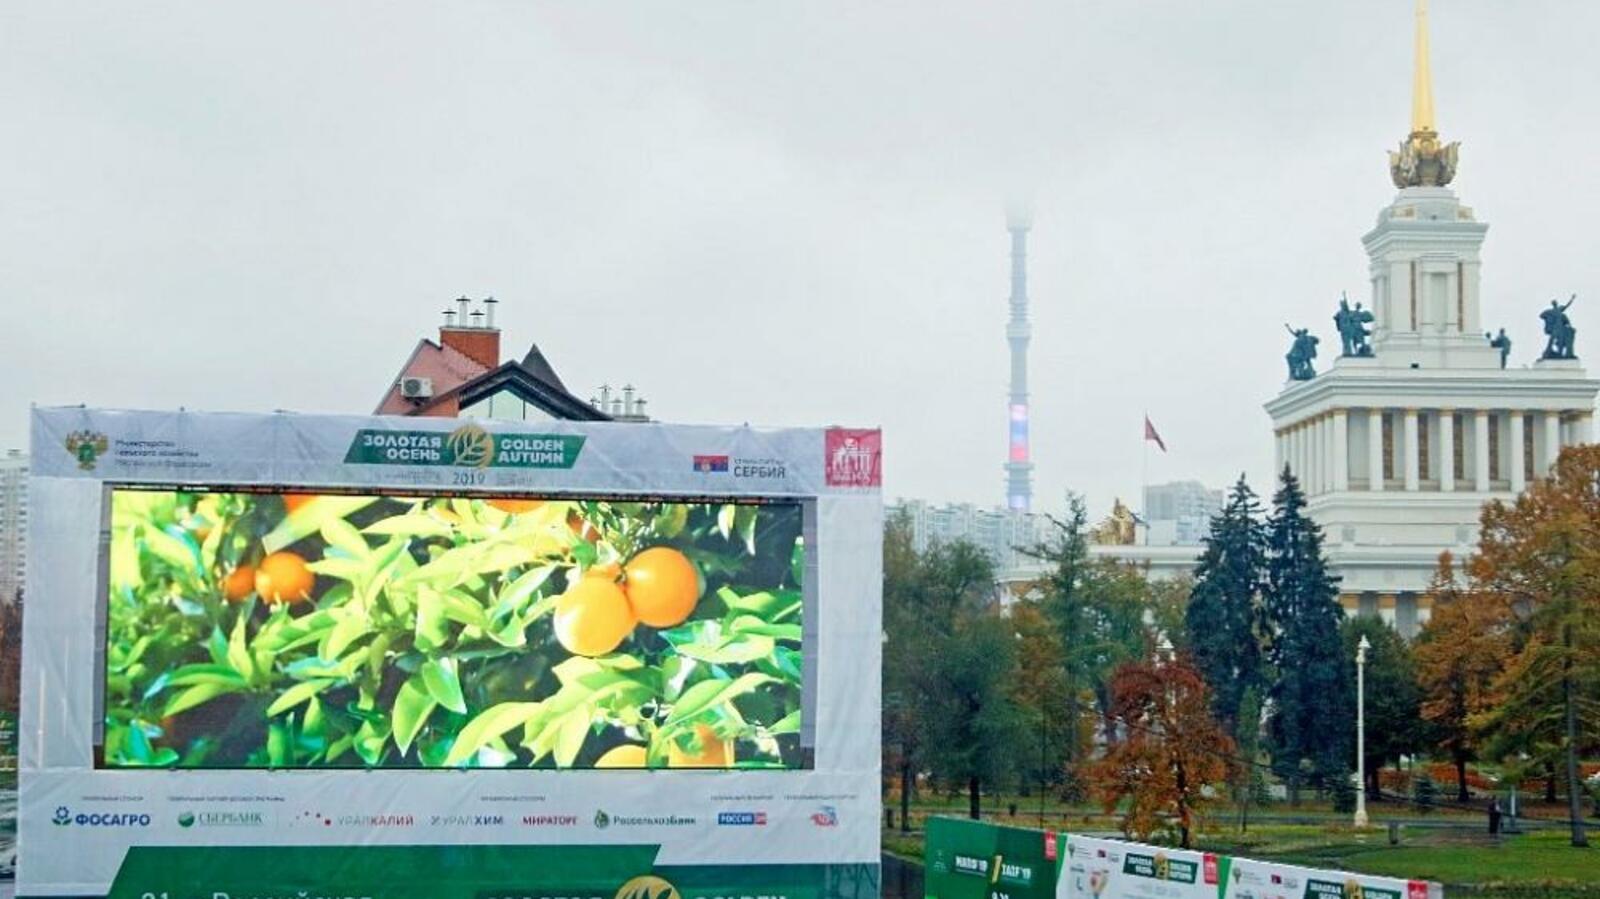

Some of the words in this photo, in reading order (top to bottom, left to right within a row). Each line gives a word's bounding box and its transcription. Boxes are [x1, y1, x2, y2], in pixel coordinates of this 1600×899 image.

[363, 434, 442, 448] ЗОЛОТАЯ
[501, 438, 565, 451] GOLDEN
[386, 448, 441, 461] ОСЕНЬ
[499, 450, 565, 463] AUTUMN
[452, 471, 486, 485] 2019
[733, 466, 785, 479] СЕРБИЯ
[75, 813, 151, 826] ФОСАГРО
